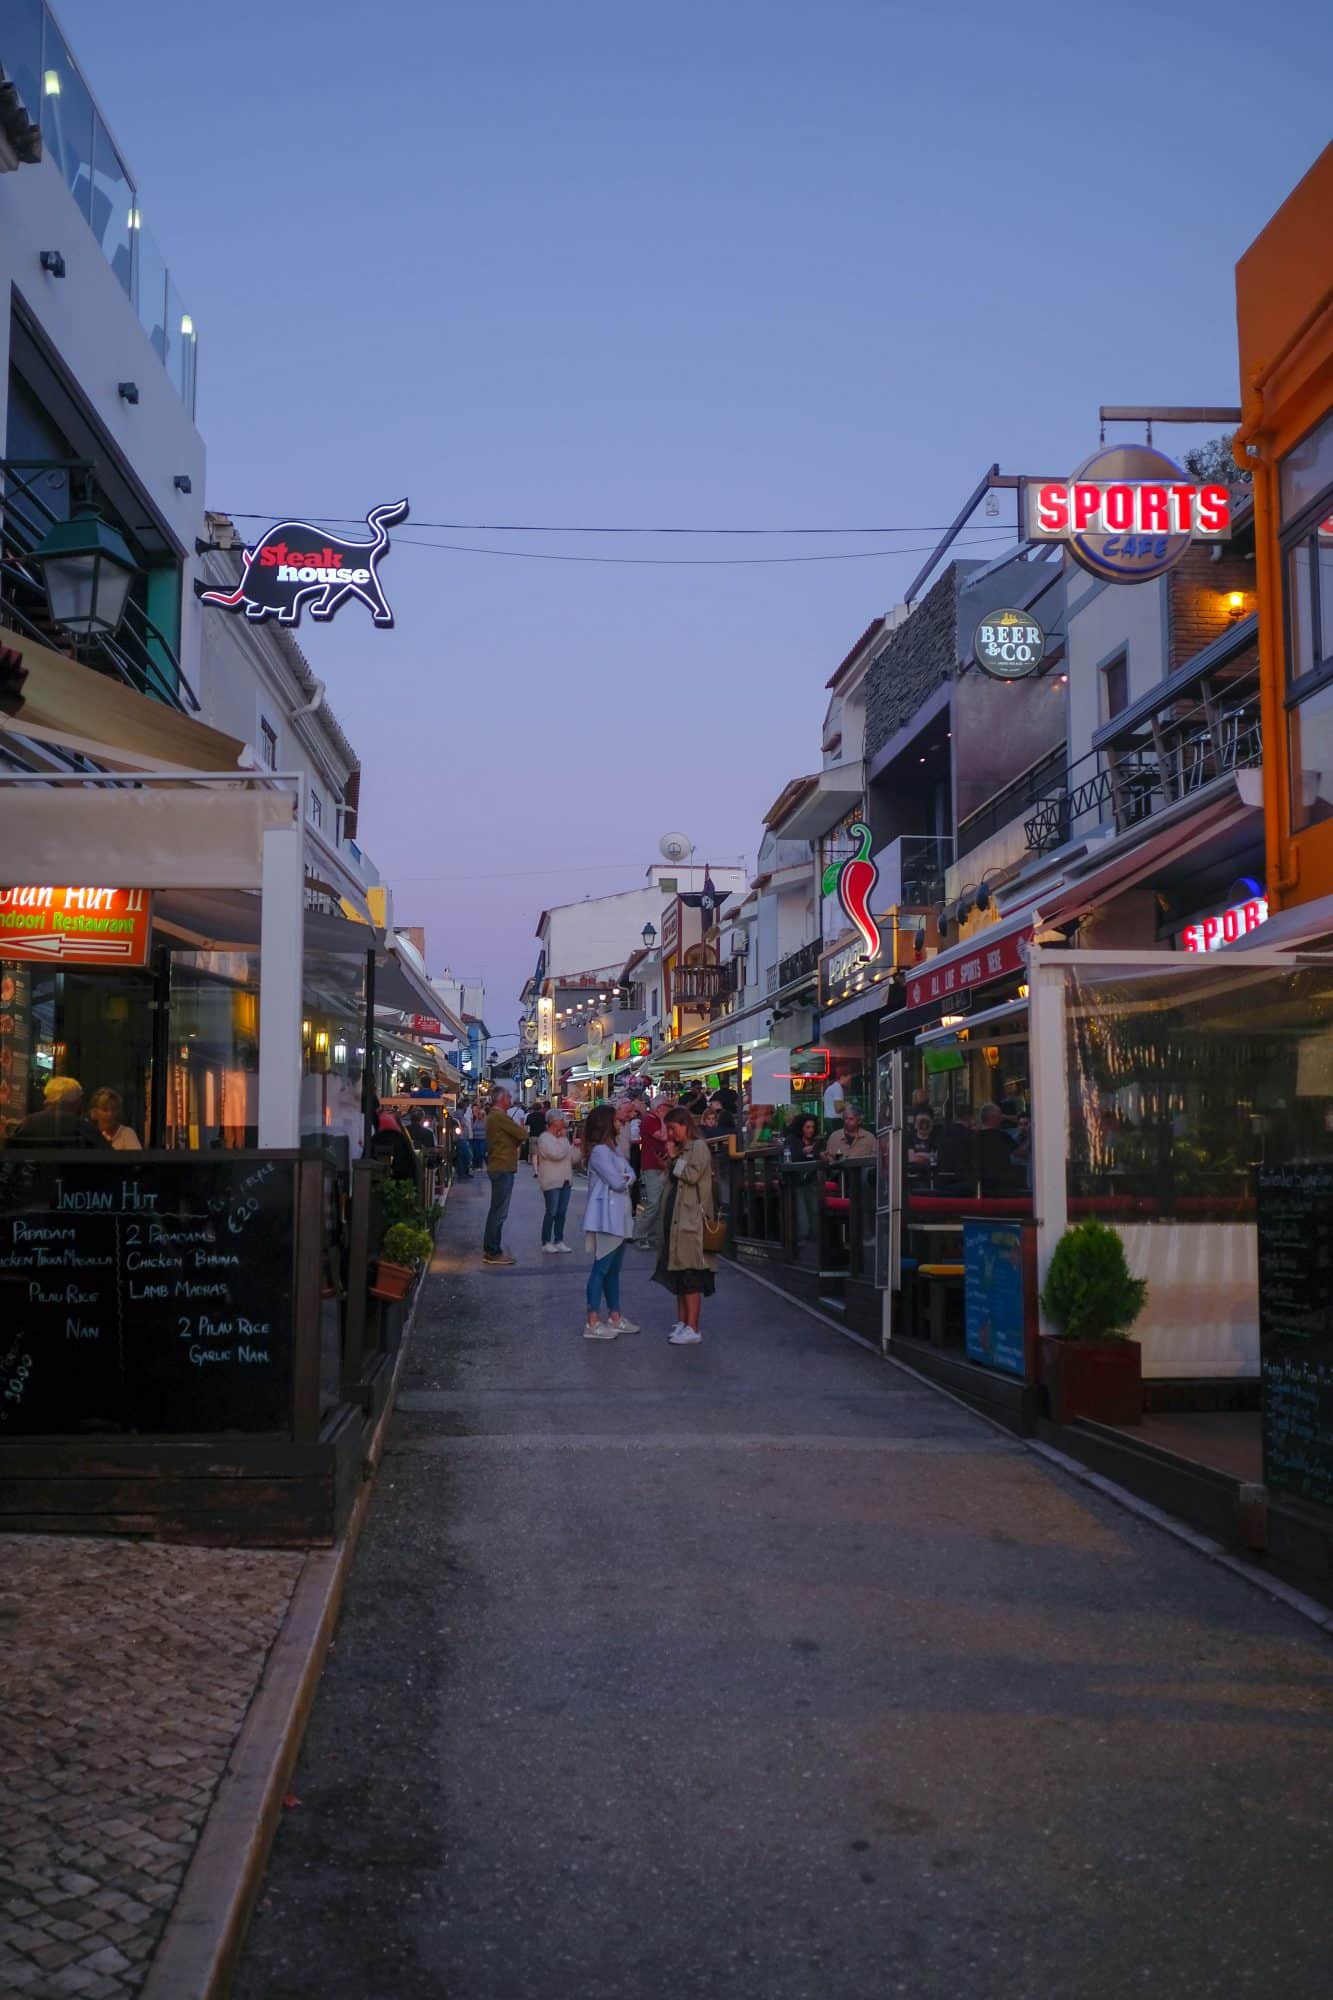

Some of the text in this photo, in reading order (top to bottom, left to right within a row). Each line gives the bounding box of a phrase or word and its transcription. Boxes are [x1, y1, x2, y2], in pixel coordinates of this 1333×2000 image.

[1037, 484, 1230, 533] SPORTS
[277, 565, 371, 583] house
[981, 626, 1041, 644] BEER
[52, 911, 134, 933] Restaurant
[1182, 896, 1269, 954] SPOR
[960, 957, 982, 985] SPORTS
[55, 1178, 113, 1210] INDIAN
[125, 1223, 143, 1246] 2
[126, 1251, 184, 1271] CHICKEN
[129, 1280, 169, 1300] LAMB
[65, 1316, 100, 1339] NAN
[178, 1314, 273, 1338] 2 PILAU RICE
[188, 1344, 271, 1367] GARLIC NAN
